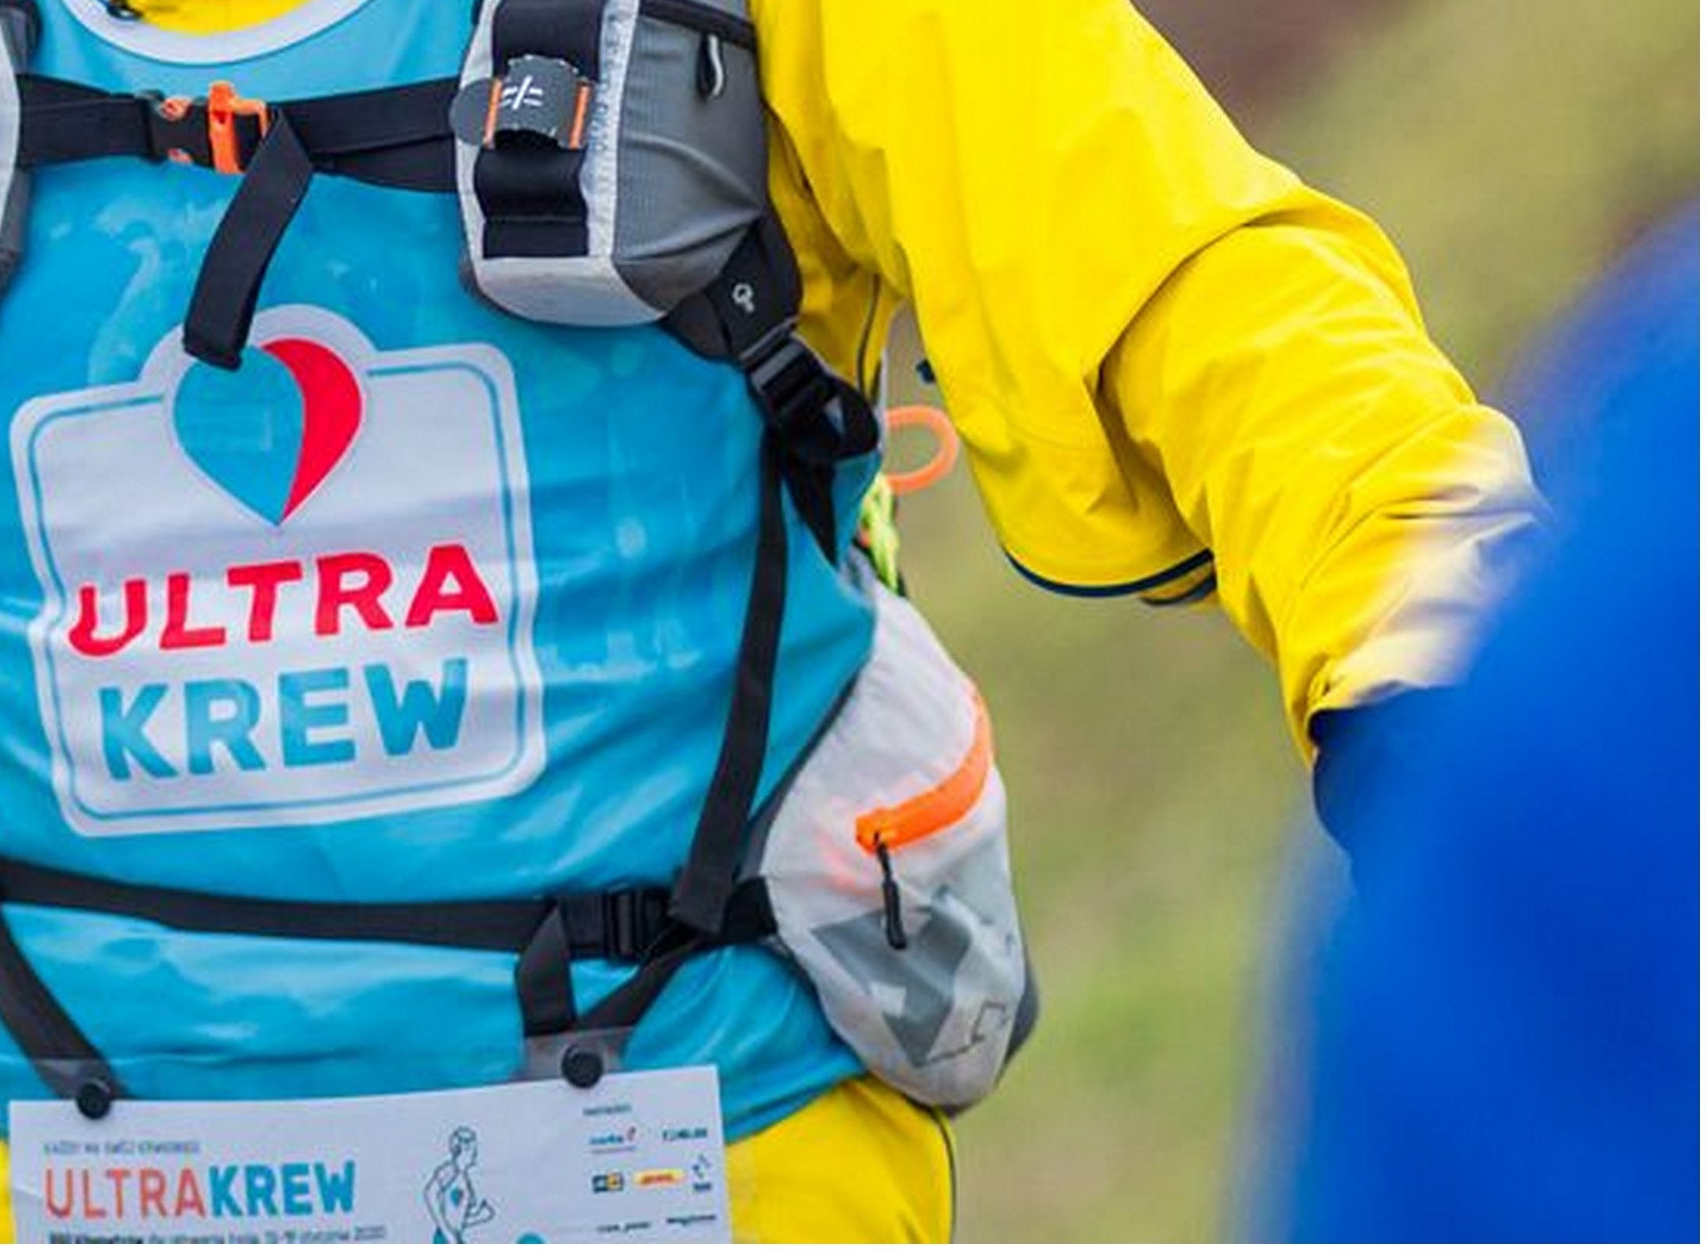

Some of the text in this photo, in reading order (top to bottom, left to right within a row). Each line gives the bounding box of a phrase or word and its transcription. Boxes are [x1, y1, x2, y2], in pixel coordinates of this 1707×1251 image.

[68, 543, 499, 657] ULTRA
[98, 657, 467, 782] KREW
[44, 1160, 356, 1220] ULTRAKREW
